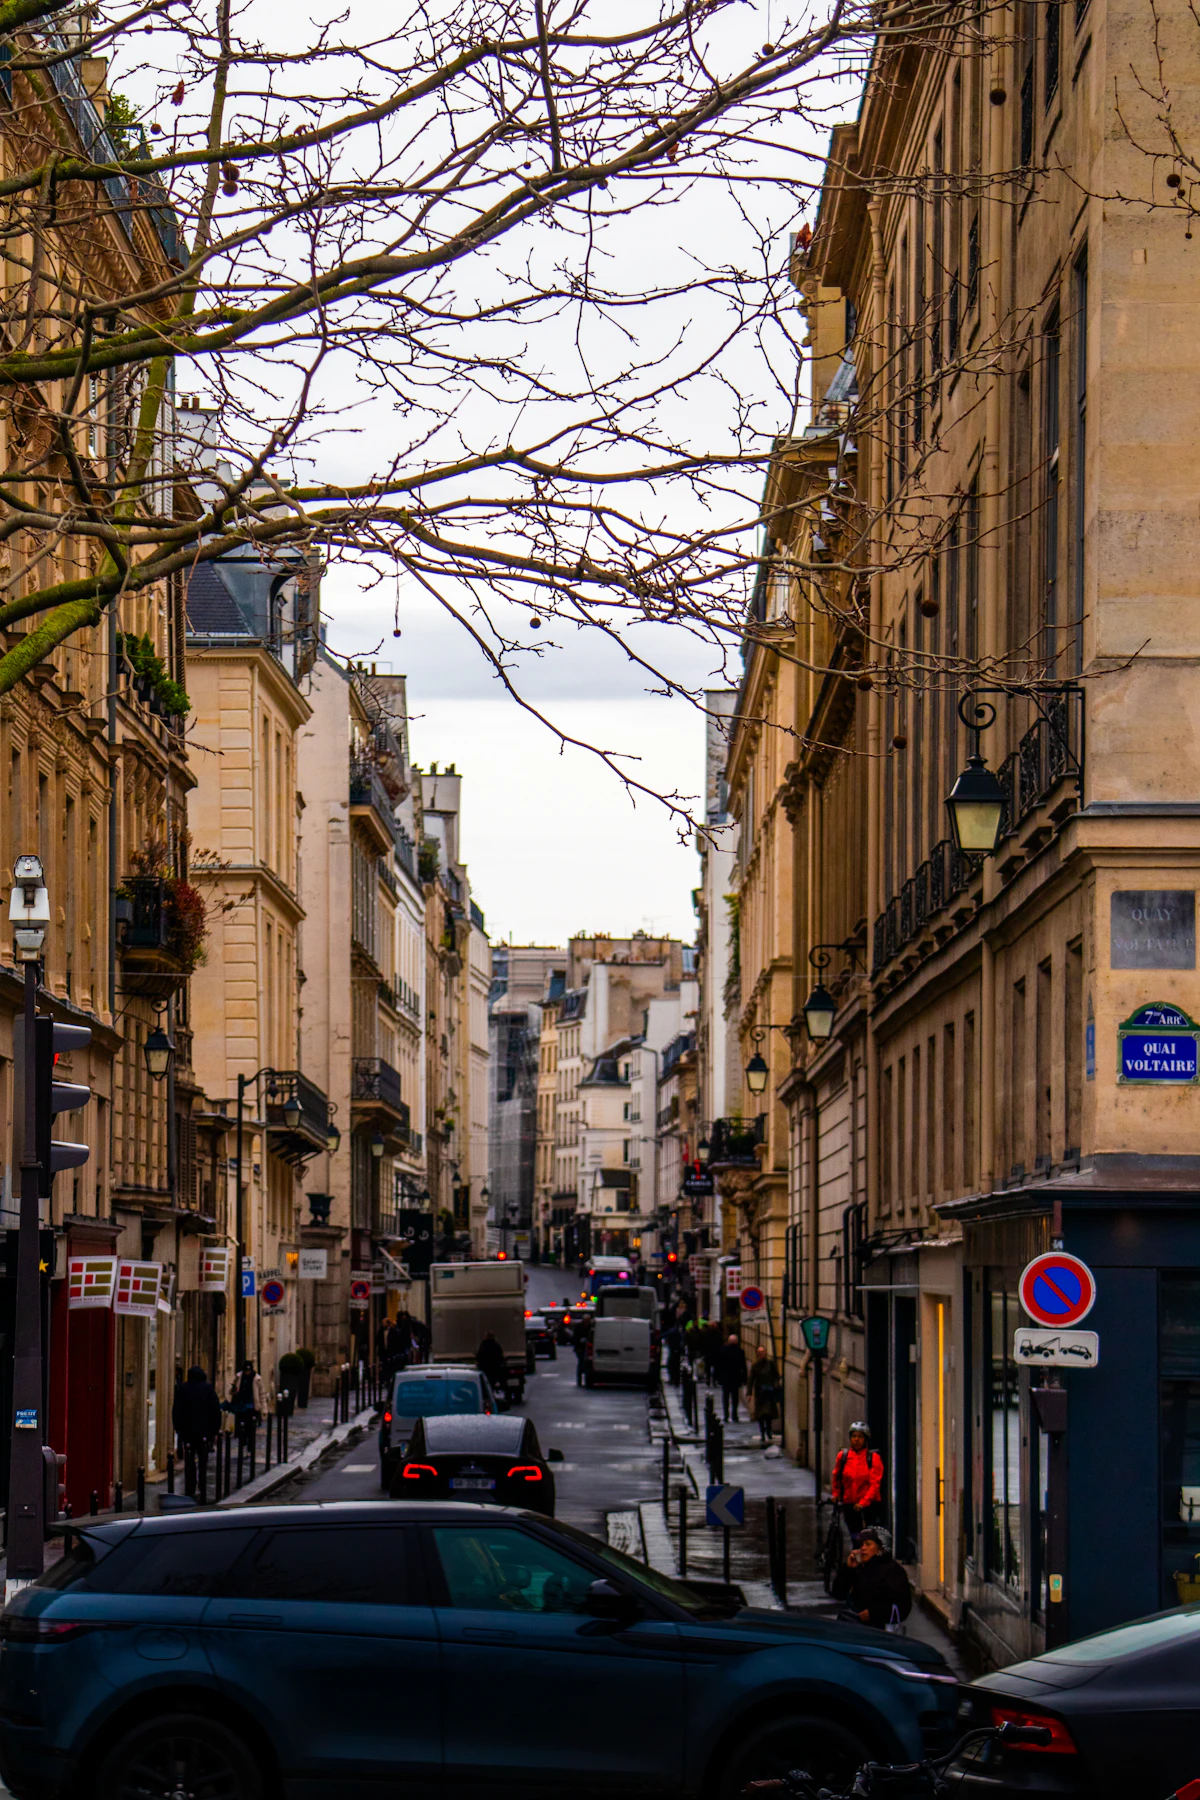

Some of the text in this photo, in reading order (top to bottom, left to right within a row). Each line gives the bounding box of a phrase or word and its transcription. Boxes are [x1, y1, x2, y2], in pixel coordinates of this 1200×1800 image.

[1132, 908, 1174, 926] QUAY
[1143, 1042, 1176, 1056] QUAI
[1125, 1059, 1195, 1072] VOLTAIRE
[257, 1269, 282, 1279] RAPPEL
[242, 1275, 250, 1291] P
